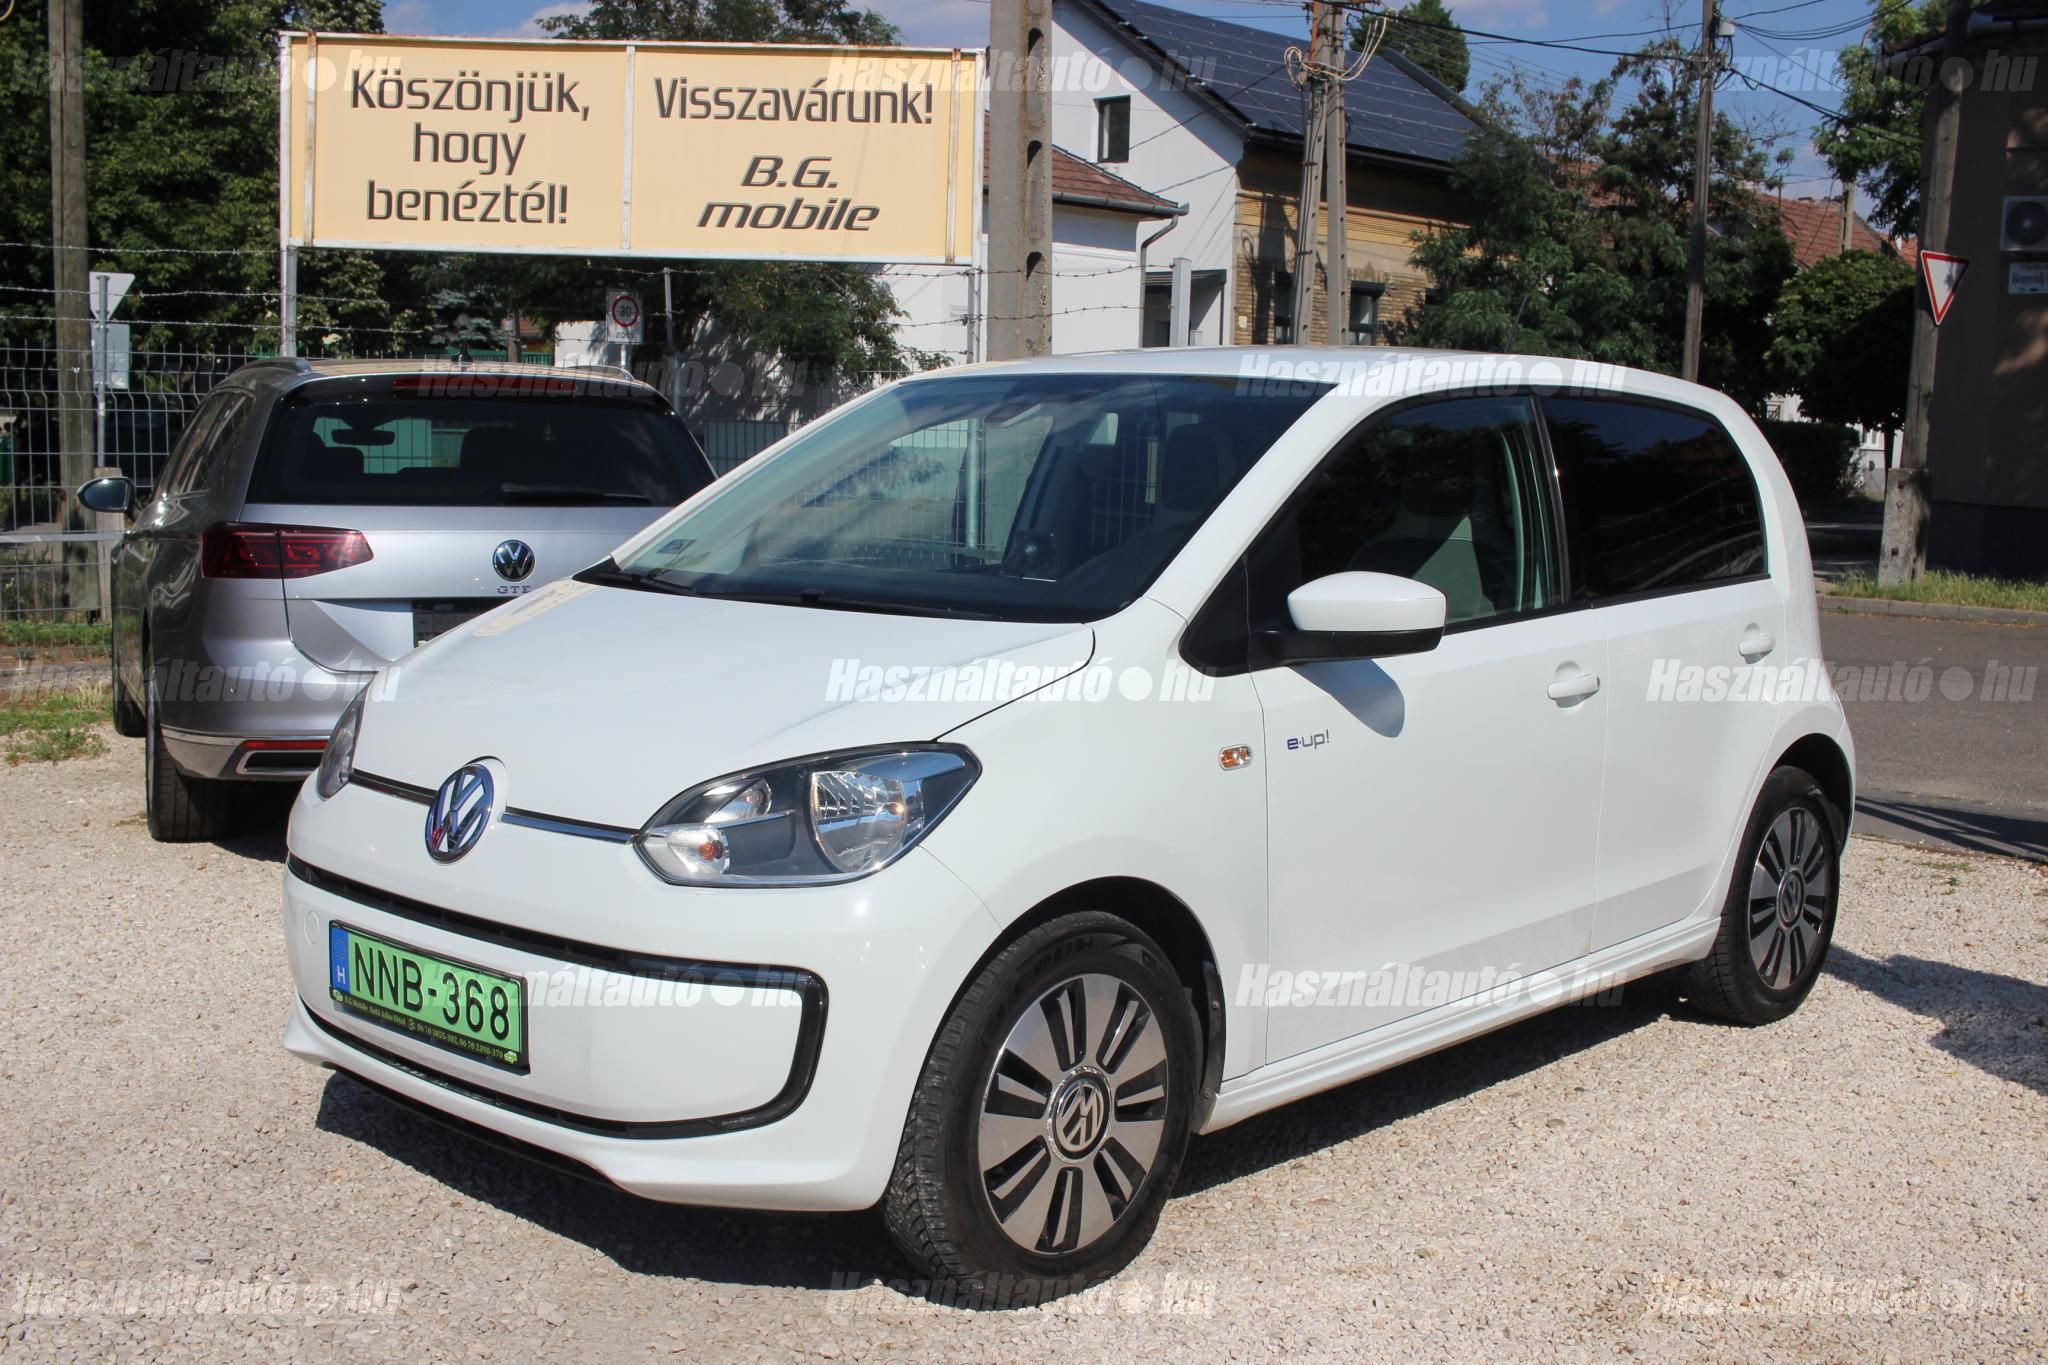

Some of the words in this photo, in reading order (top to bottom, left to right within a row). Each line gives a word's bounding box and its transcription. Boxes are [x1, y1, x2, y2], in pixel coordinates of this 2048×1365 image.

[351, 69, 590, 123] Köszönjük,
[654, 77, 933, 124] Visszavárunk!
[413, 121, 527, 176] hogy
[740, 155, 839, 188] B.G.
[367, 179, 568, 224] benéztél!
[696, 197, 881, 231] mobile
[619, 306, 632, 317] 30
[497, 585, 531, 594] GTE
[336, 965, 346, 985] H
[354, 942, 510, 1041] NNB-368
